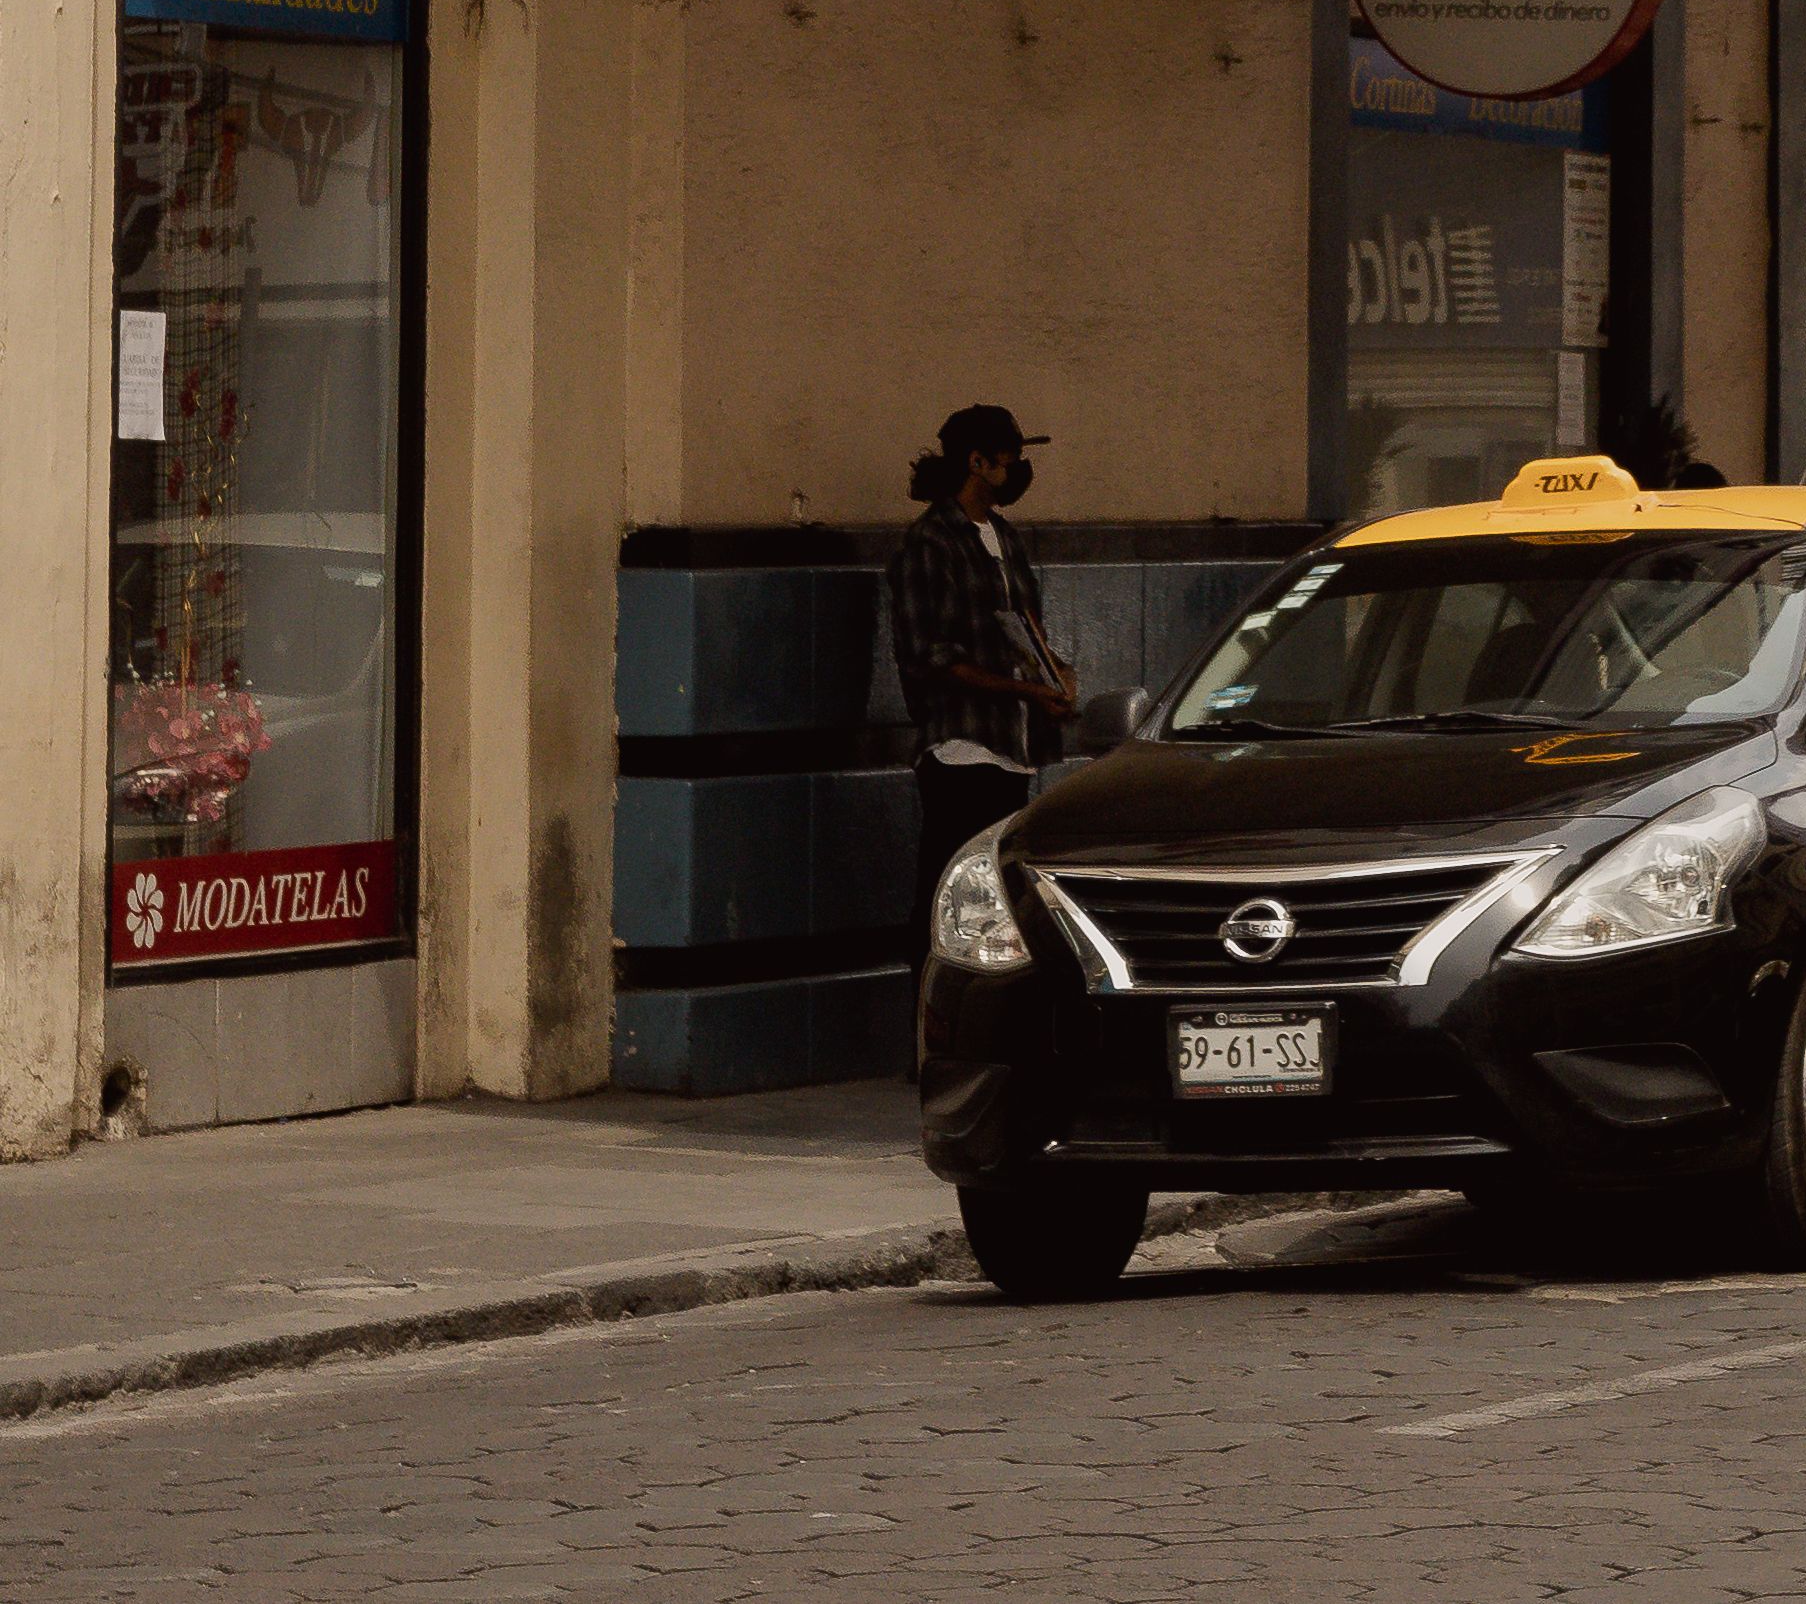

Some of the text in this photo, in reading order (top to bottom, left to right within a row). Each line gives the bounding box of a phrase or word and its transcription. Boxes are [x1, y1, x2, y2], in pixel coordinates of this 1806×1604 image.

[1445, 0, 1510, 20] recibo
[1514, 0, 1540, 20] de
[1544, 0, 1611, 21] dinero
[1540, 472, 1598, 493] TAXI
[173, 868, 369, 934] MODATELAS
